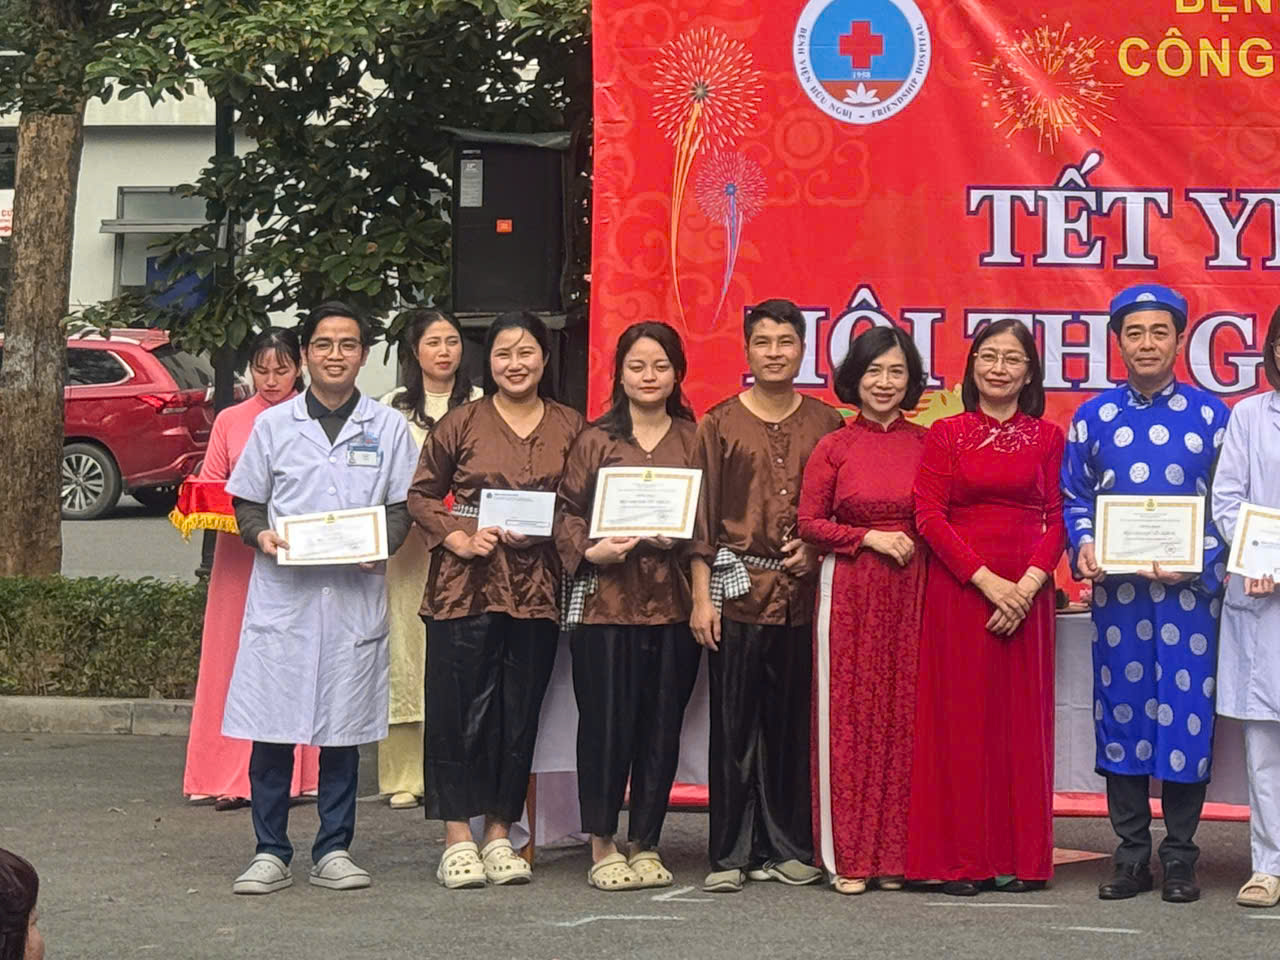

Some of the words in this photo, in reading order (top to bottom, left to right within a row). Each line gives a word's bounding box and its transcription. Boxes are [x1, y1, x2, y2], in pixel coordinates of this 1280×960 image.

[871, 77, 918, 118] FRIENDSHIP
[915, 23, 927, 74] HOSPITAL
[1117, 27, 1274, 77] CÔNG
[966, 149, 1173, 269] TẾT
